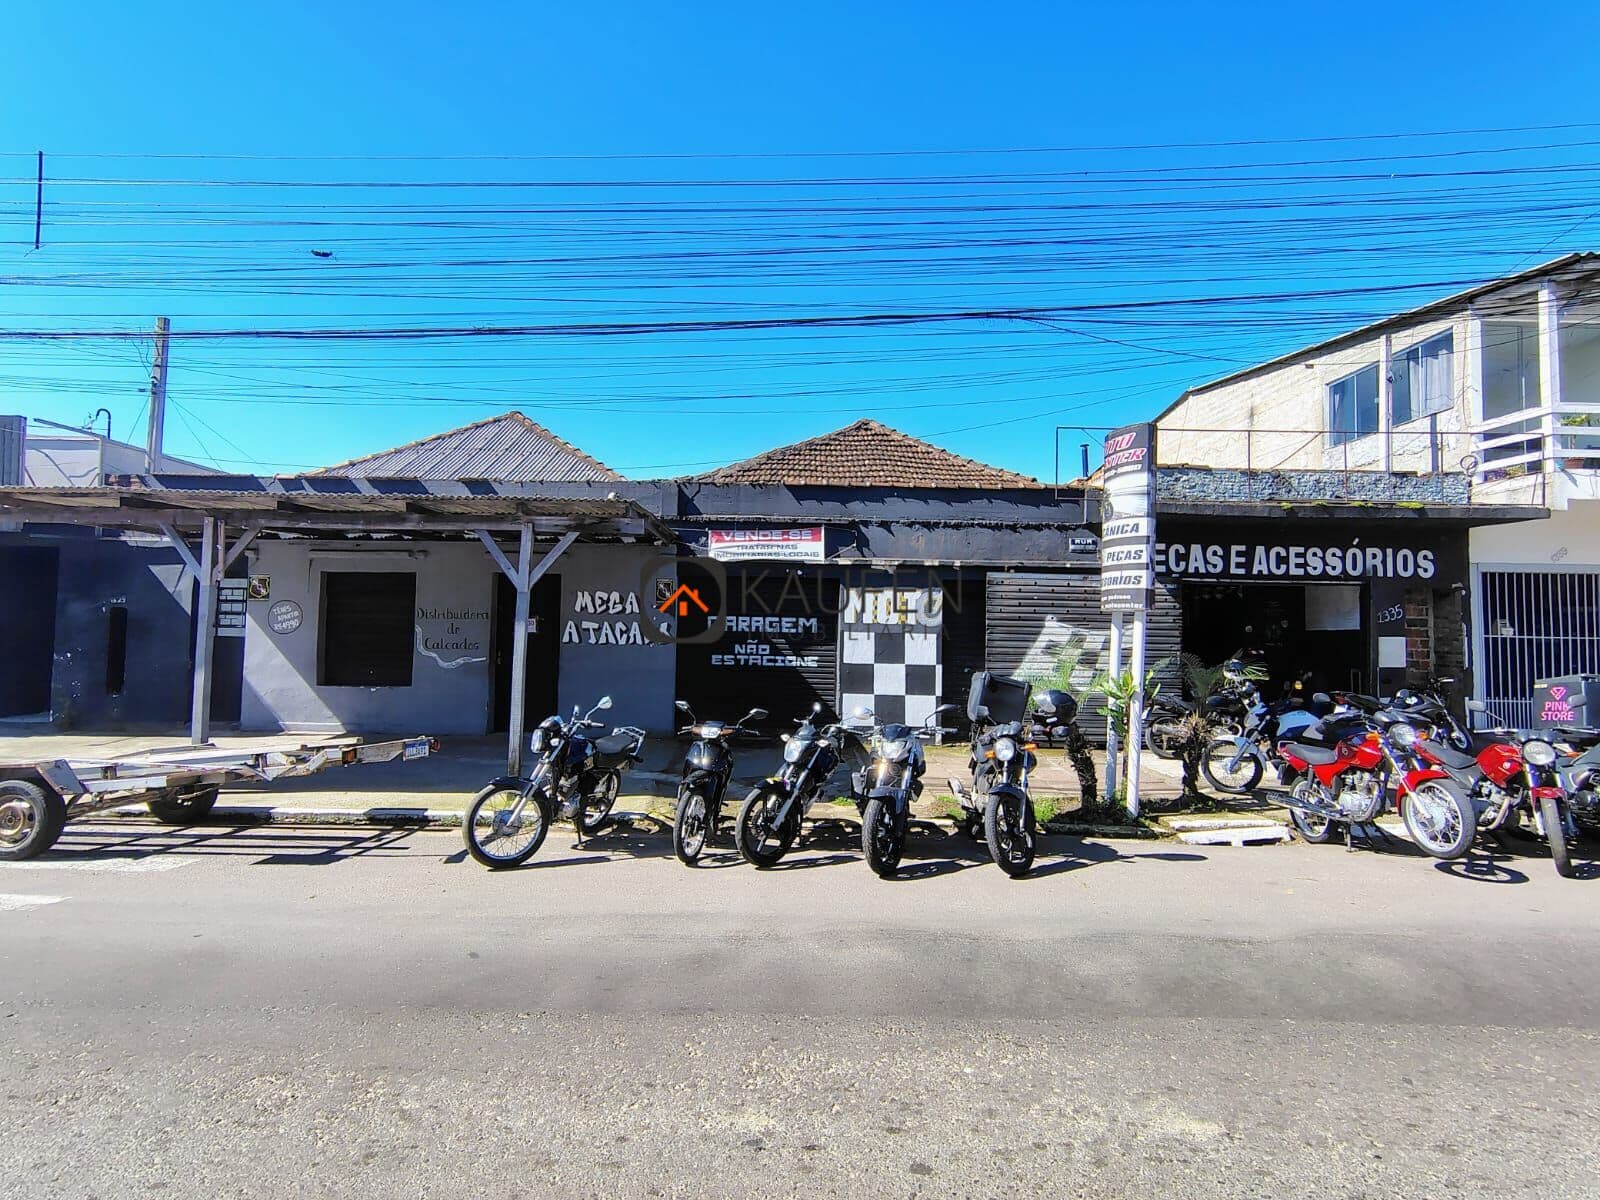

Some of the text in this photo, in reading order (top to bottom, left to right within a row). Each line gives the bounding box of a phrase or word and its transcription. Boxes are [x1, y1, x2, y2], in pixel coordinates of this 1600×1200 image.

[720, 530, 814, 541] VENDE-SE
[1155, 537, 1436, 579] EÇAS E ACESSÓRIOS
[575, 591, 640, 614] MEGA
[1377, 604, 1403, 622] 1335
[562, 620, 672, 646] ATACA
[735, 640, 770, 655] NÃO
[711, 655, 819, 667] ESTACIONE
[1544, 701, 1570, 711] PINK
[1541, 711, 1575, 721] STORE
